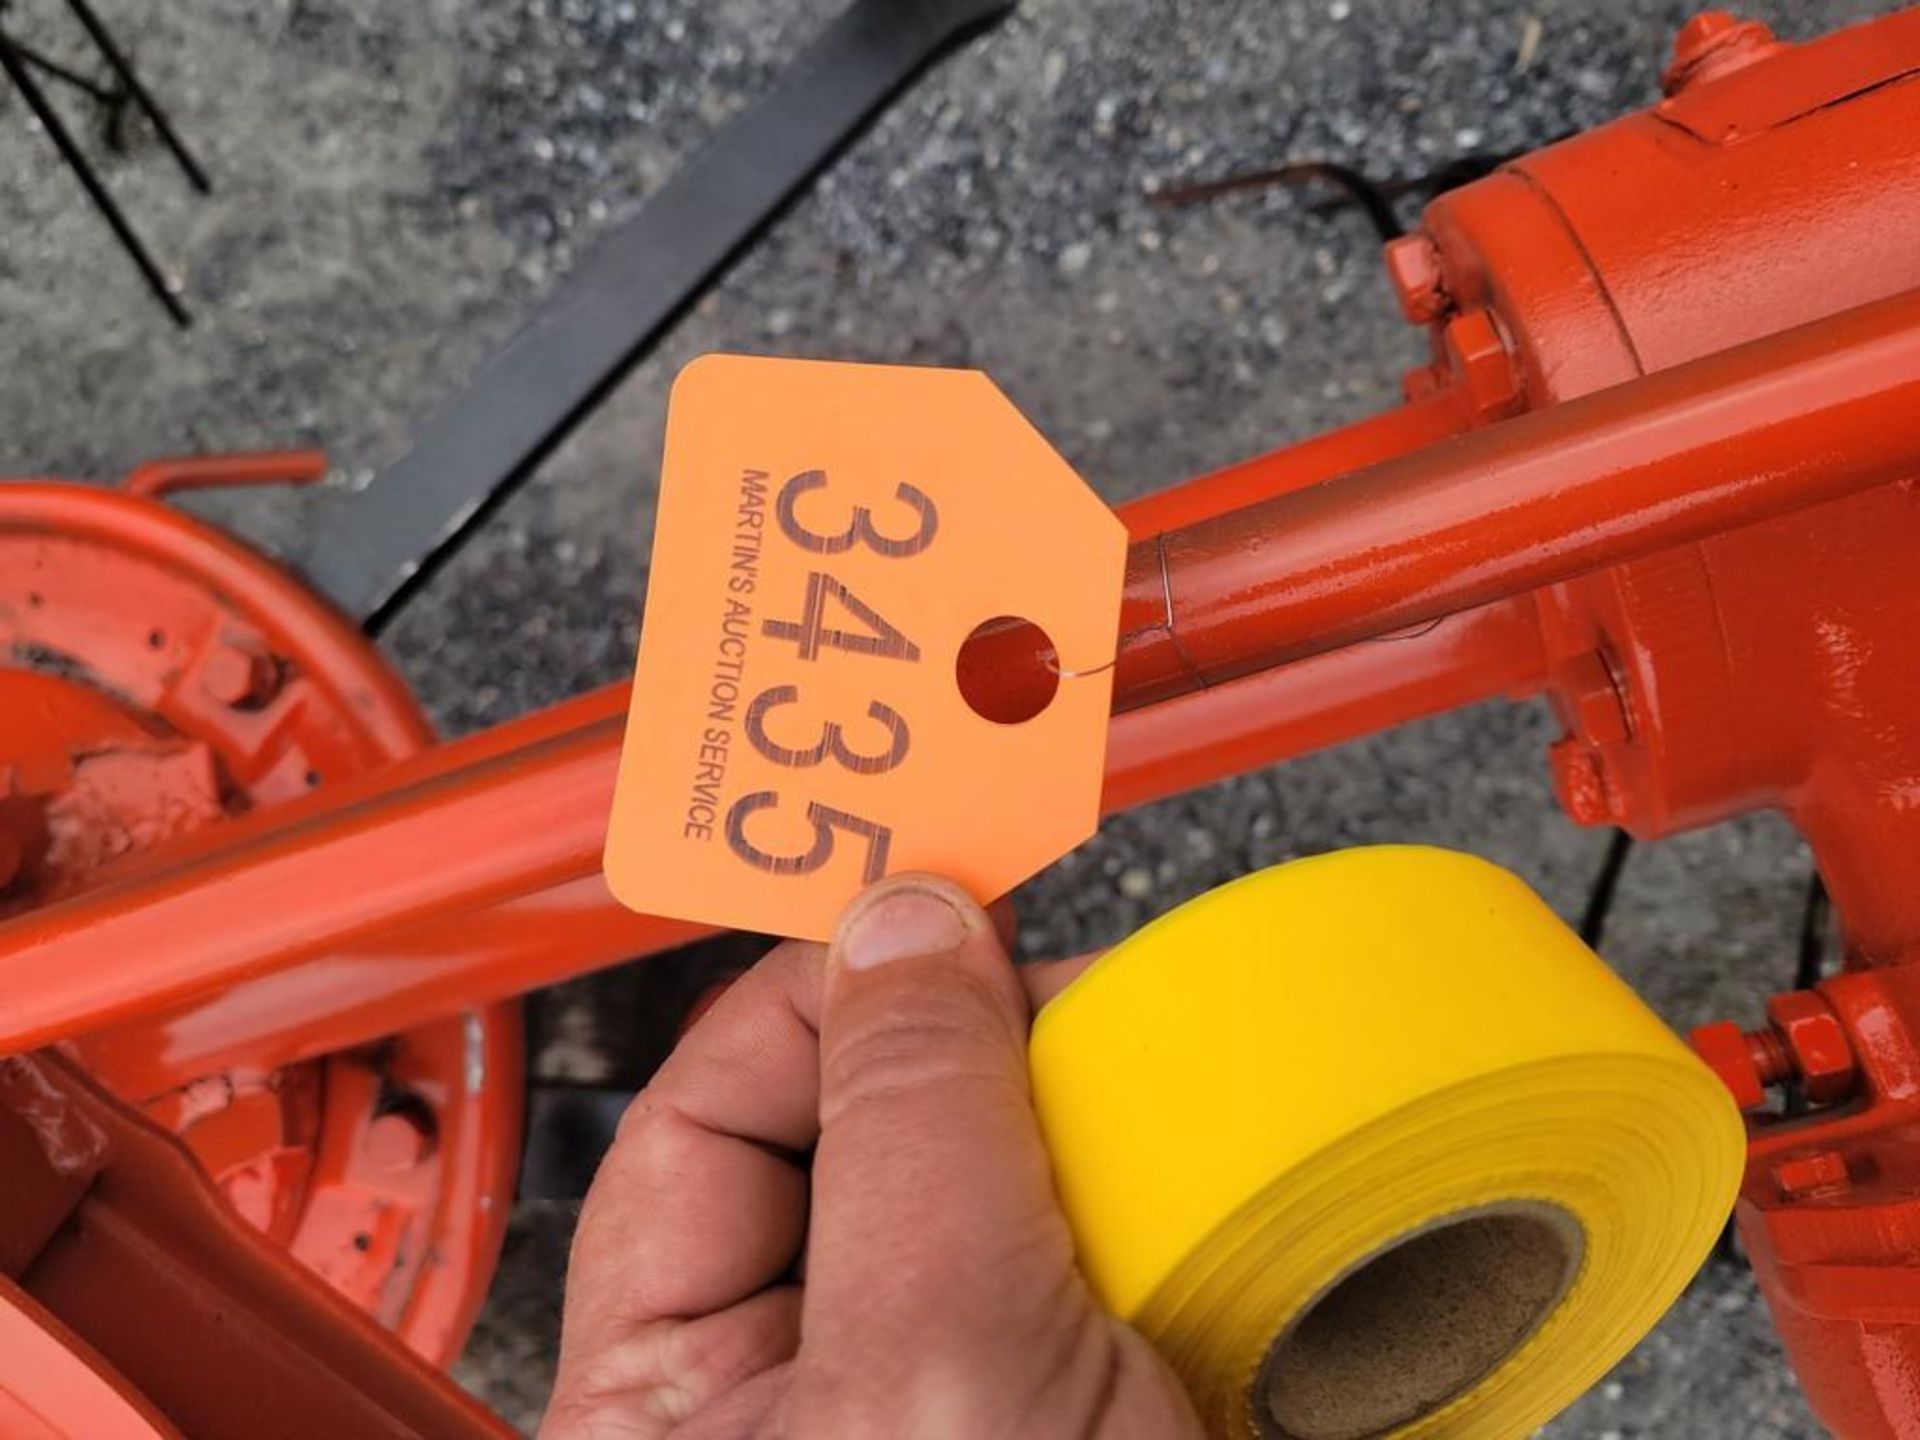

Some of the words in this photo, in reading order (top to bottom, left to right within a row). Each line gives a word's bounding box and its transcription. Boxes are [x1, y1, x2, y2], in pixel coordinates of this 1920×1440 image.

[728, 469, 769, 595] MARTIN'S
[708, 597, 748, 722] AUCTION
[725, 469, 939, 886] 3435
[684, 727, 731, 841] SERVICE
